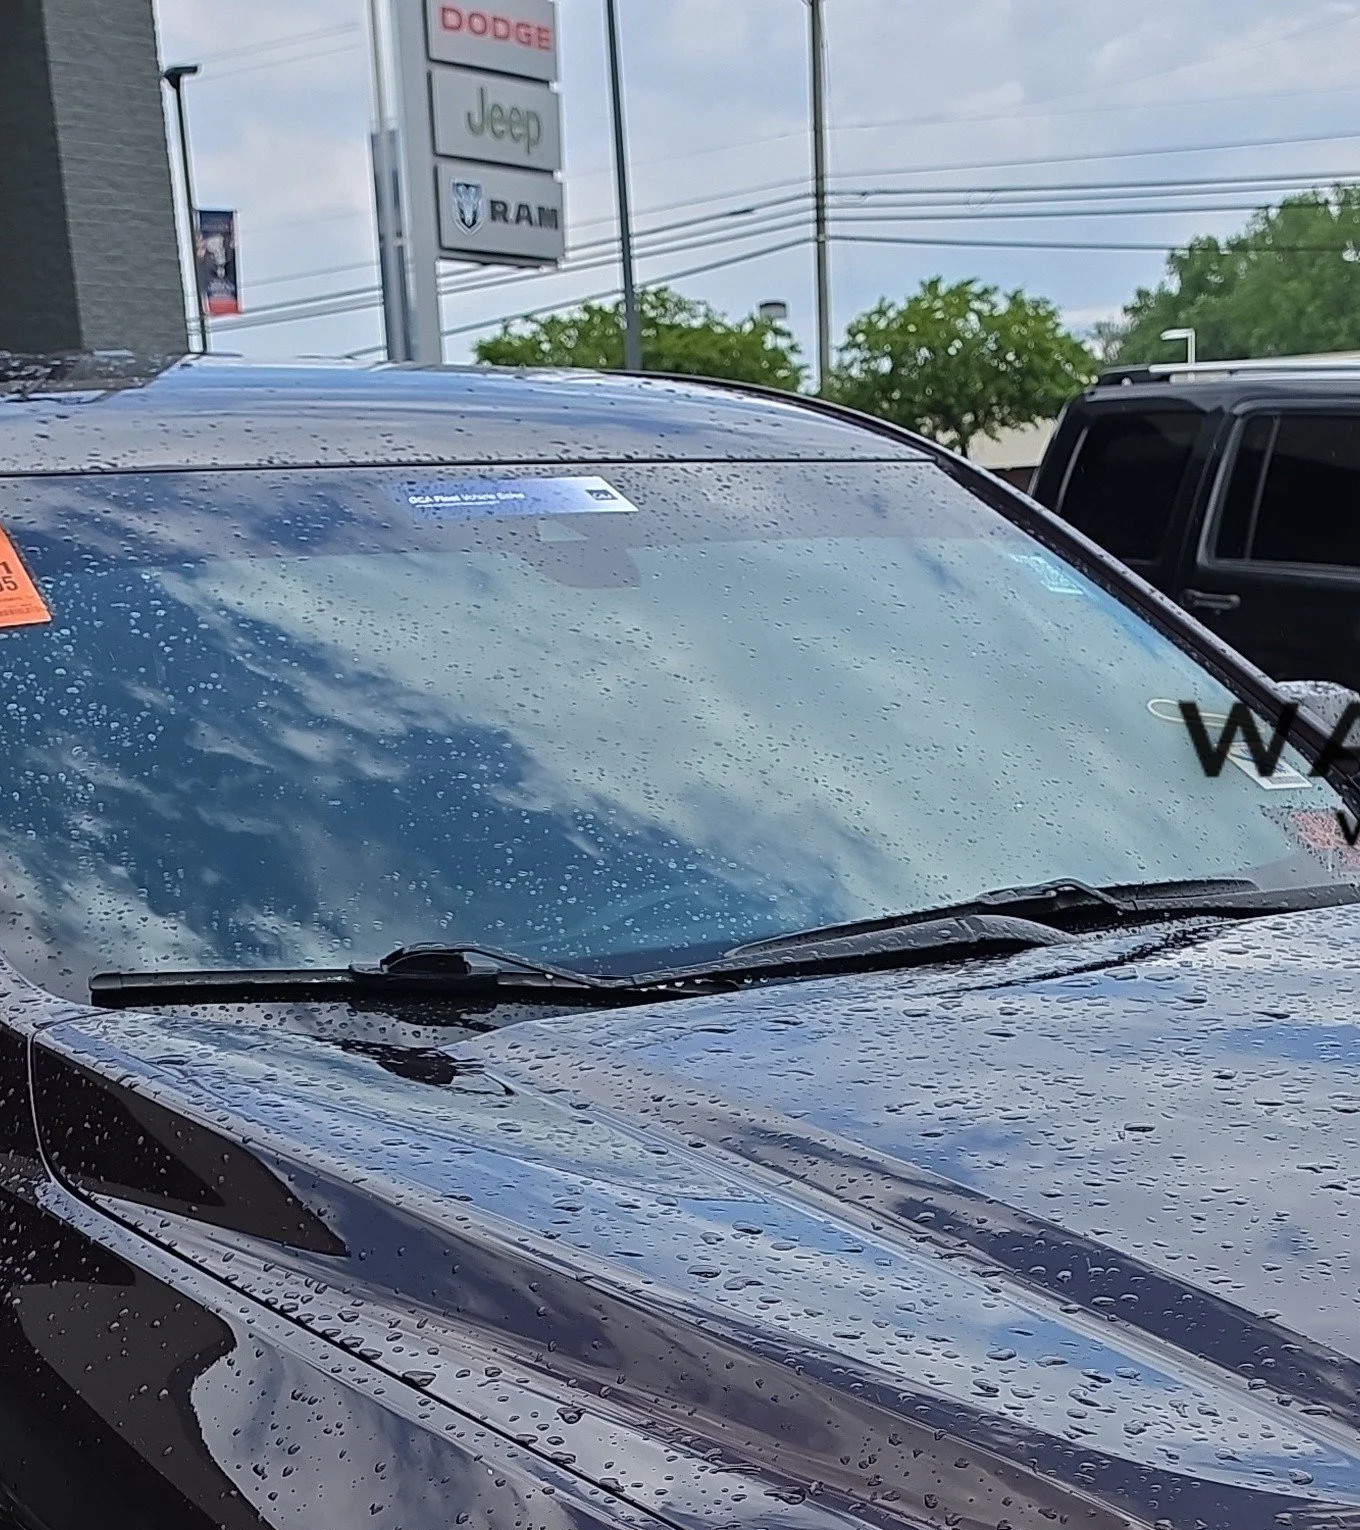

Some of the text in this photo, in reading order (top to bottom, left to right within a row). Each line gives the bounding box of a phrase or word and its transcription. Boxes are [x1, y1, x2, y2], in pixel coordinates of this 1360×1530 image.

[440, 7, 551, 50] DODGE
[467, 86, 541, 154] Jeep
[490, 200, 559, 230] RAM
